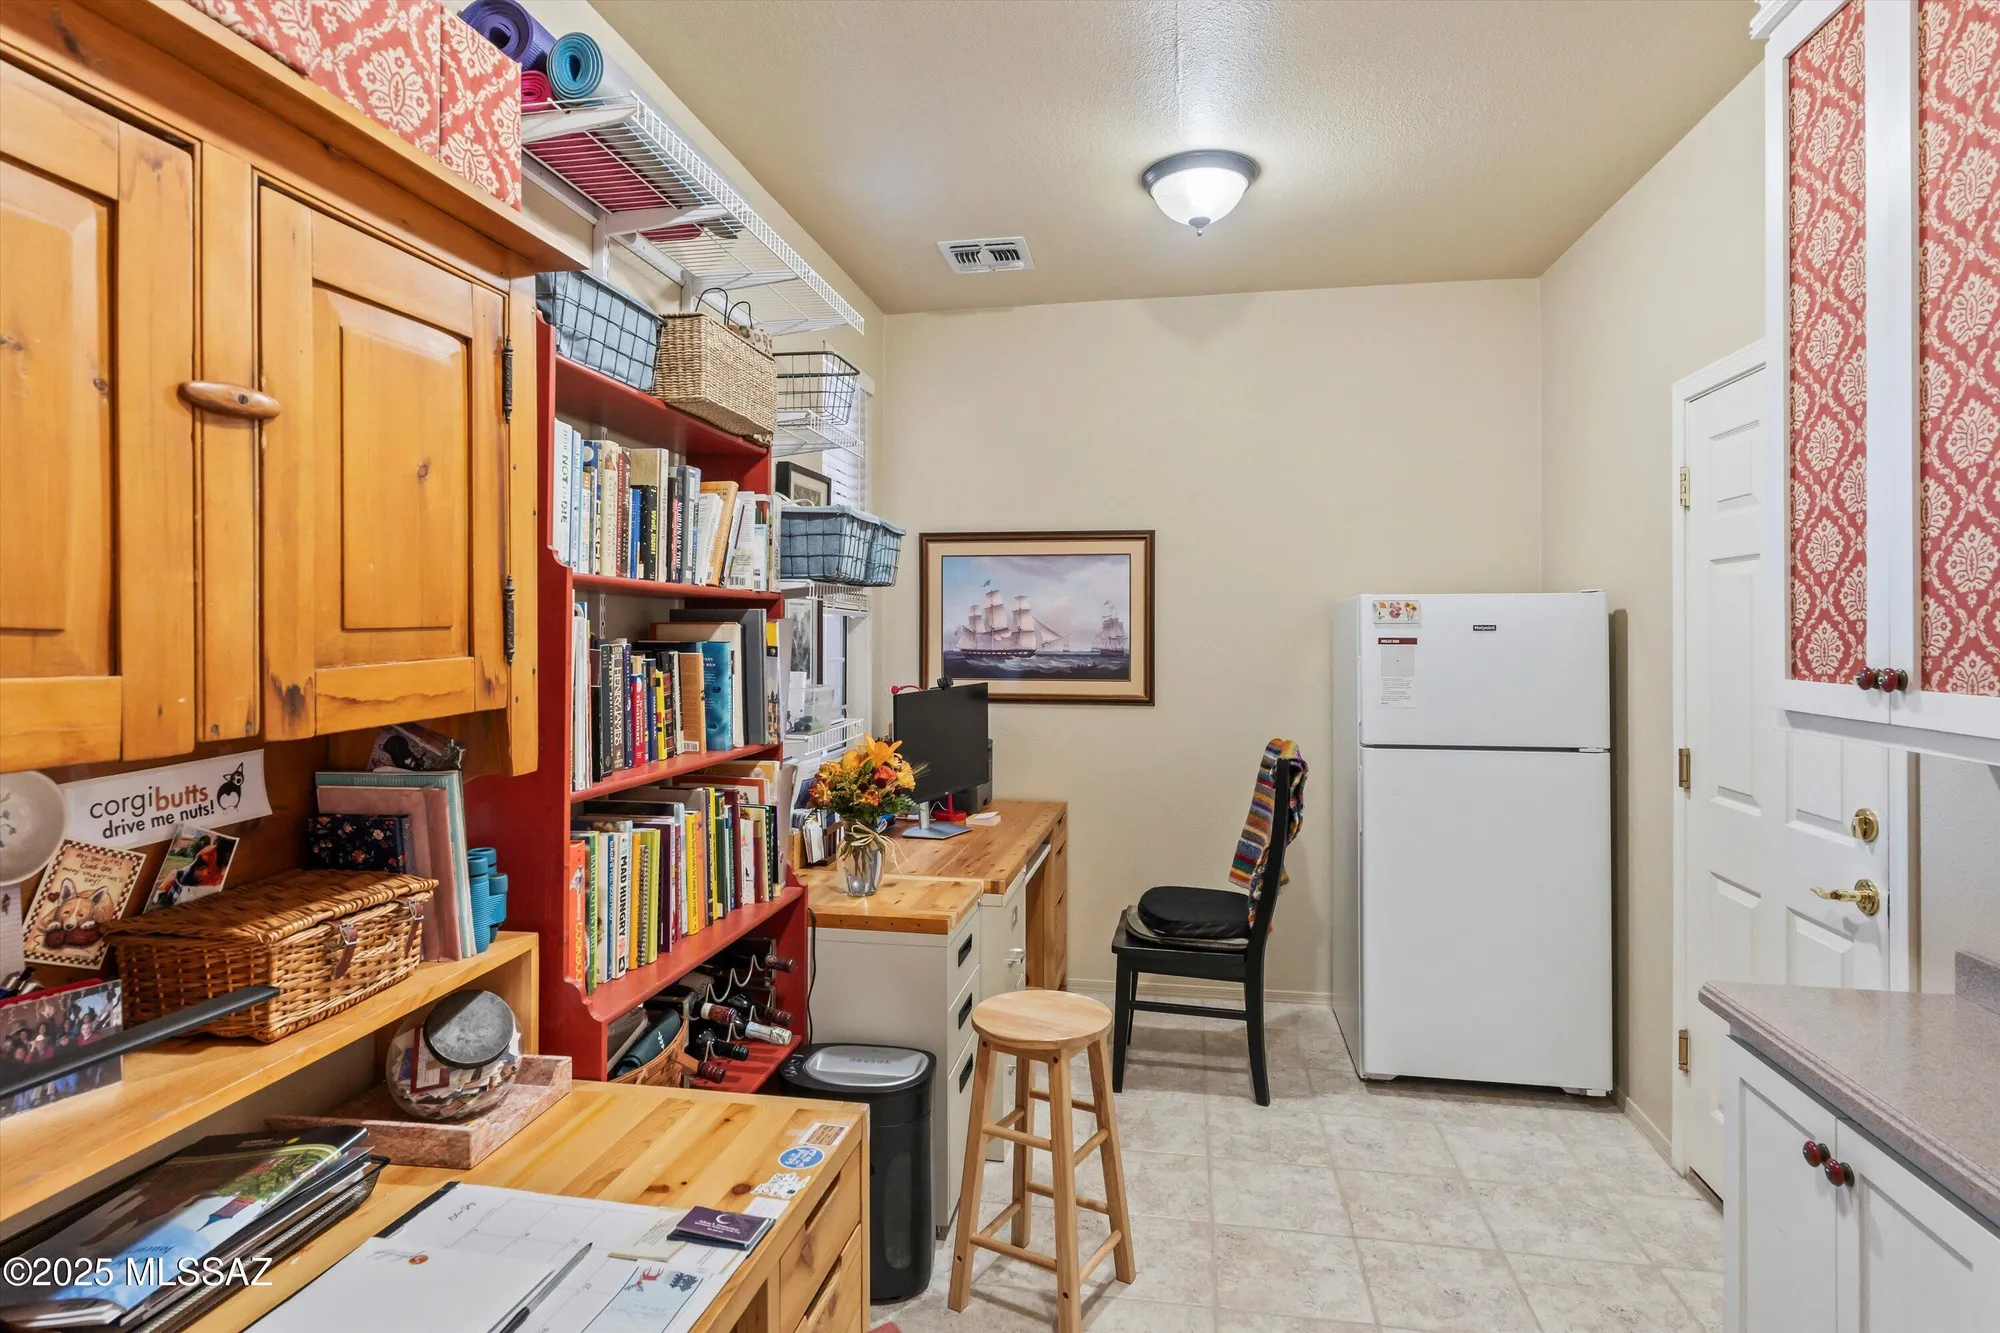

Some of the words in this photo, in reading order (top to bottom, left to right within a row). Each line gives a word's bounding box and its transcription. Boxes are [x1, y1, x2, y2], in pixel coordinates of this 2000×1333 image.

[561, 454, 569, 485] NOT
[560, 500, 569, 524] DIE
[614, 667, 622, 707] HENRY
[614, 706, 622, 746] JAMES
[102, 818, 145, 839] drive
[151, 812, 175, 828] me
[180, 800, 215, 821] nuts!
[620, 855, 628, 884] MAD
[575, 922, 583, 983] COOKBOO
